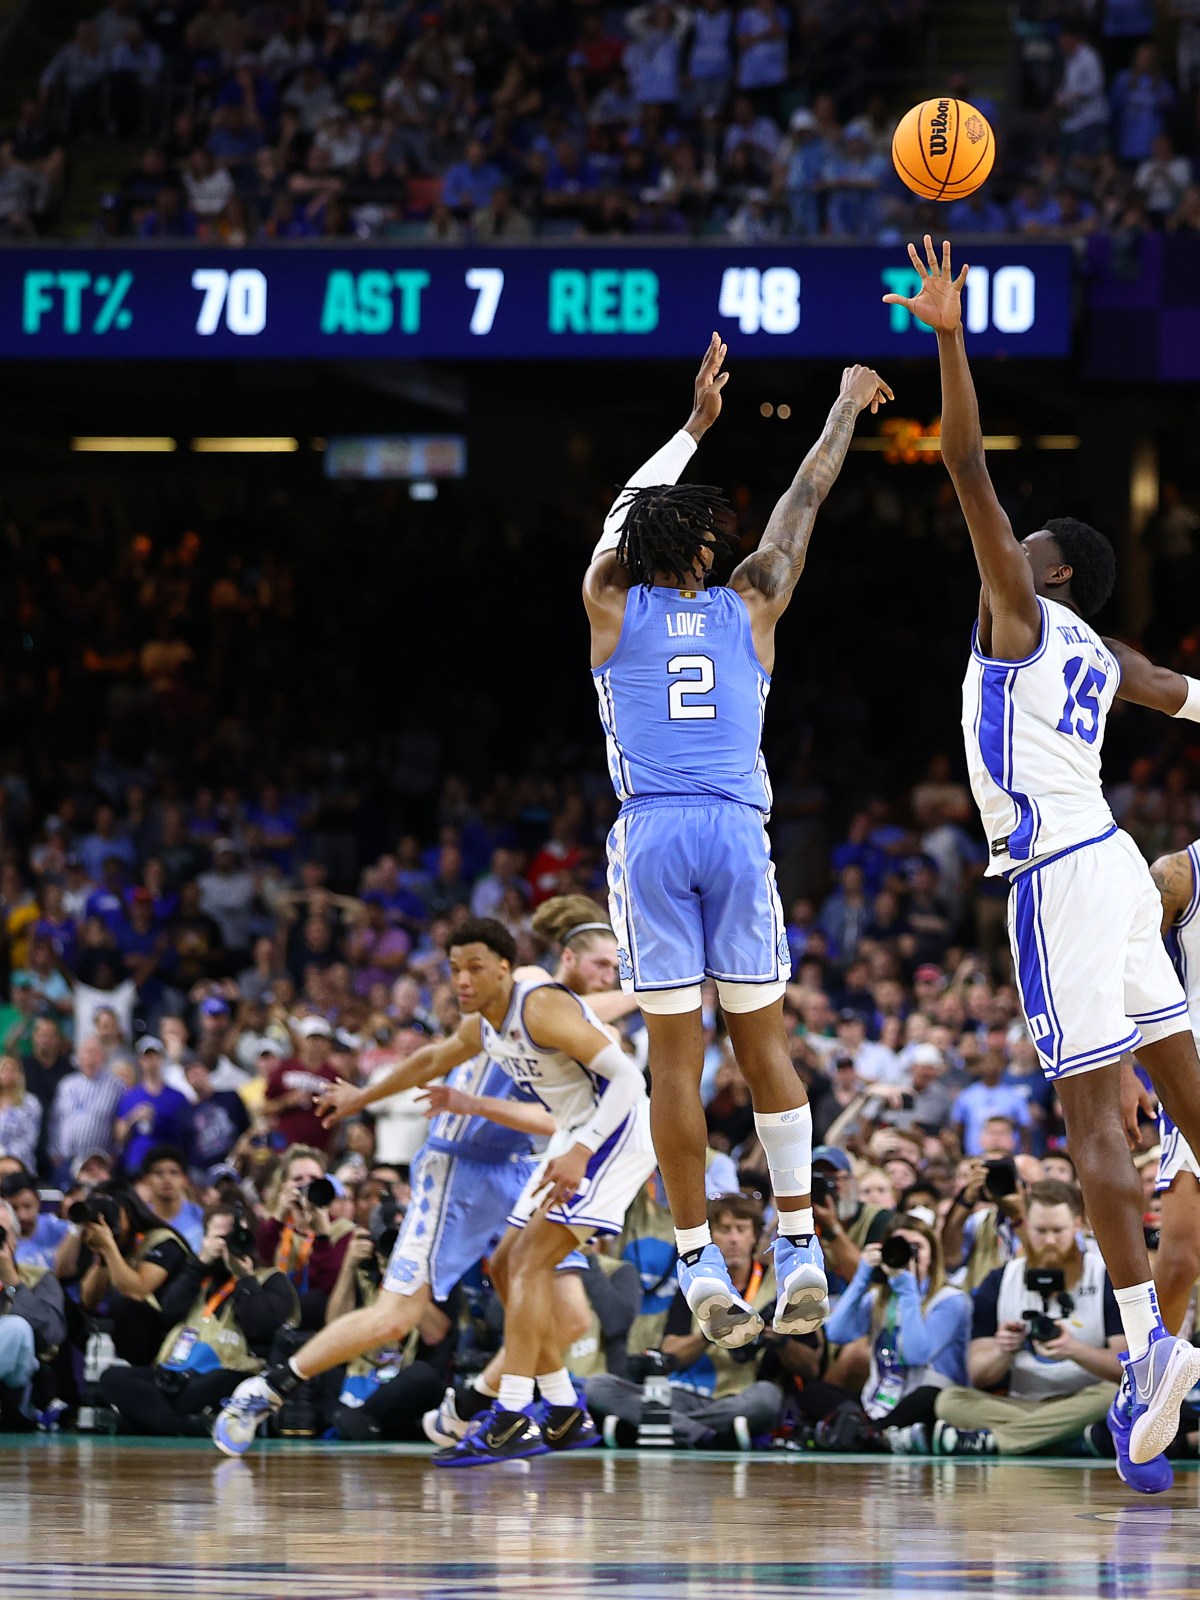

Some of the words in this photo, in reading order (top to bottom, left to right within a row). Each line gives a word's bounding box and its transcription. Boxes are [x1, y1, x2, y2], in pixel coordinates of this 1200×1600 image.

[930, 100, 950, 157] Wilson
[22, 270, 134, 335] FT%
[192, 268, 268, 336] 70
[321, 270, 430, 335] AST
[465, 268, 505, 336] 7
[548, 268, 660, 335] REB
[718, 266, 802, 335] 48
[962, 266, 1036, 334] 10
[666, 612, 707, 637] LOVE
[666, 654, 717, 721] 2
[1056, 655, 1107, 745] 15
